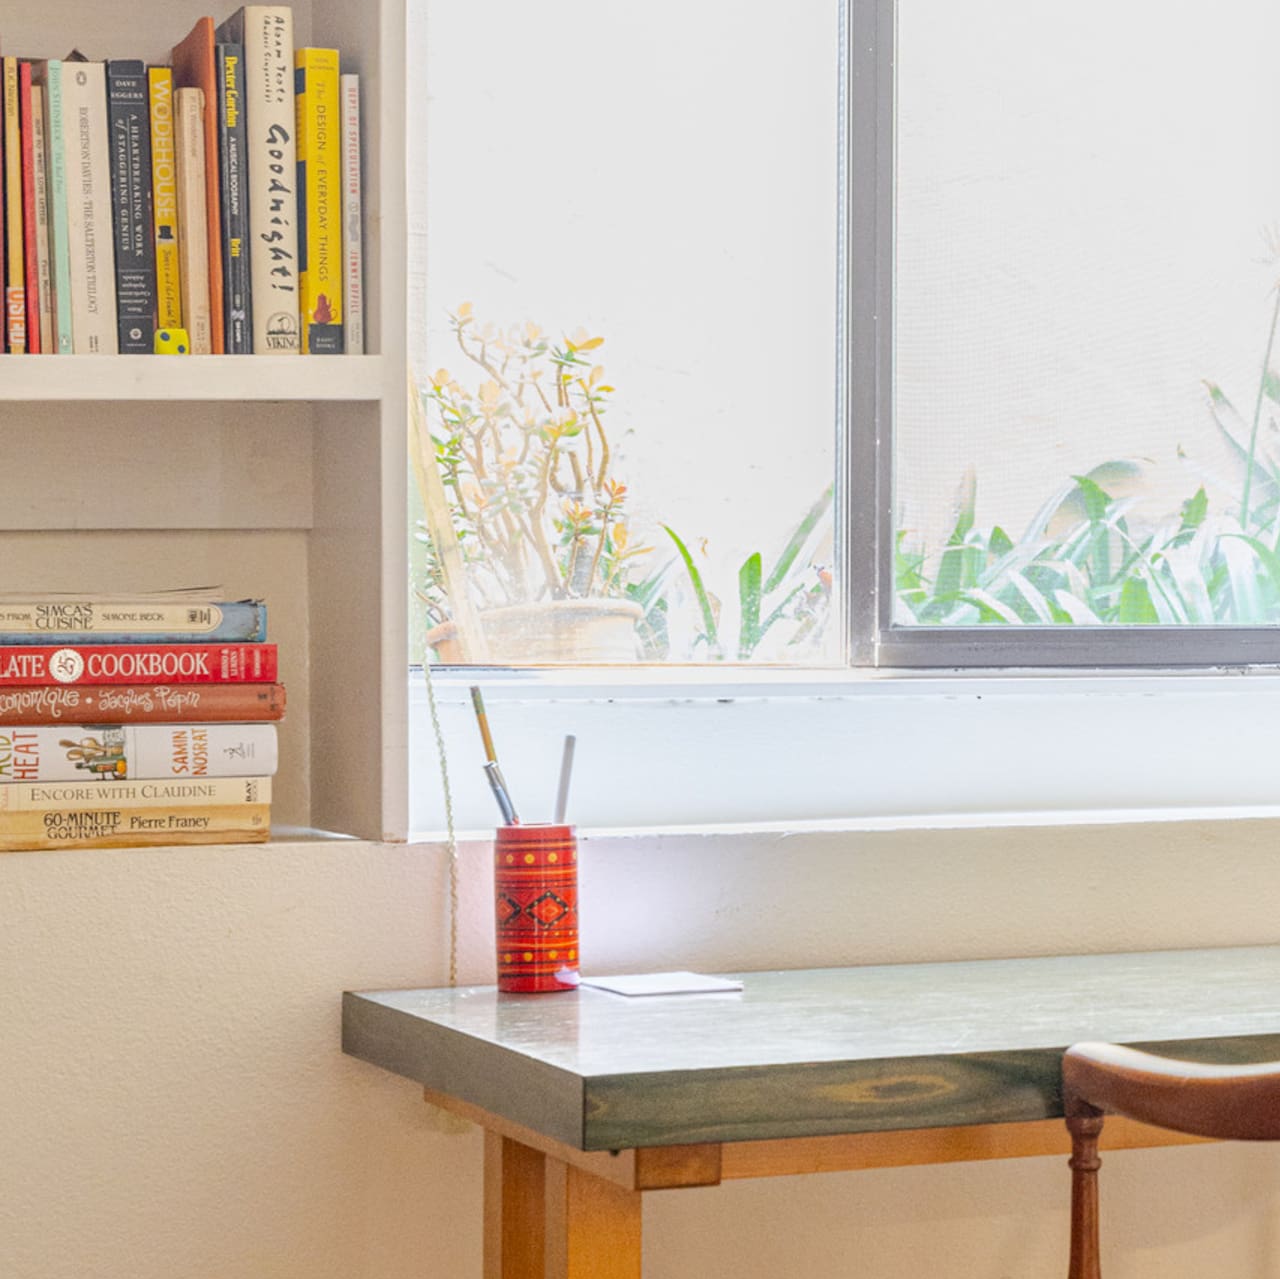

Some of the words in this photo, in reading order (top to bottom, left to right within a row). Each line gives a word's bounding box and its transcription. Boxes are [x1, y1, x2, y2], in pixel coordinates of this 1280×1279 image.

[225, 56, 237, 90] Dexter
[115, 118, 128, 130] of
[129, 113, 138, 121] A
[226, 91, 238, 127] Gordon
[315, 104, 328, 151] DESIGN
[79, 107, 91, 160] ROBERTSON
[153, 79, 177, 217] WODEHOUSE
[81, 161, 92, 195] DAVIES
[118, 134, 129, 205] STAGGERING
[131, 125, 143, 220] HEARTBREAKING
[84, 201, 94, 220] THE
[260, 122, 294, 293] Goodnight!
[316, 169, 329, 231] EVERYDAY
[85, 221, 96, 277] SALTERTON
[121, 209, 131, 251] GENIUS
[134, 224, 144, 256] WORK
[317, 234, 329, 283] THINGS
[87, 277, 99, 315] TRILOGY
[35, 616, 93, 631] CUISINE
[87, 653, 210, 677] COOKBOOK
[12, 730, 40, 780] HEAT
[172, 730, 187, 775] SAMIN
[191, 728, 208, 776] NOSRAT
[30, 788, 94, 802] ENCORE
[97, 787, 136, 800] WITH
[141, 784, 217, 799] CLAUDINE
[43, 811, 121, 827] 60-MINUTE
[46, 825, 119, 840] GOURMET
[130, 816, 167, 829] Pierre
[167, 814, 211, 829] Franey
